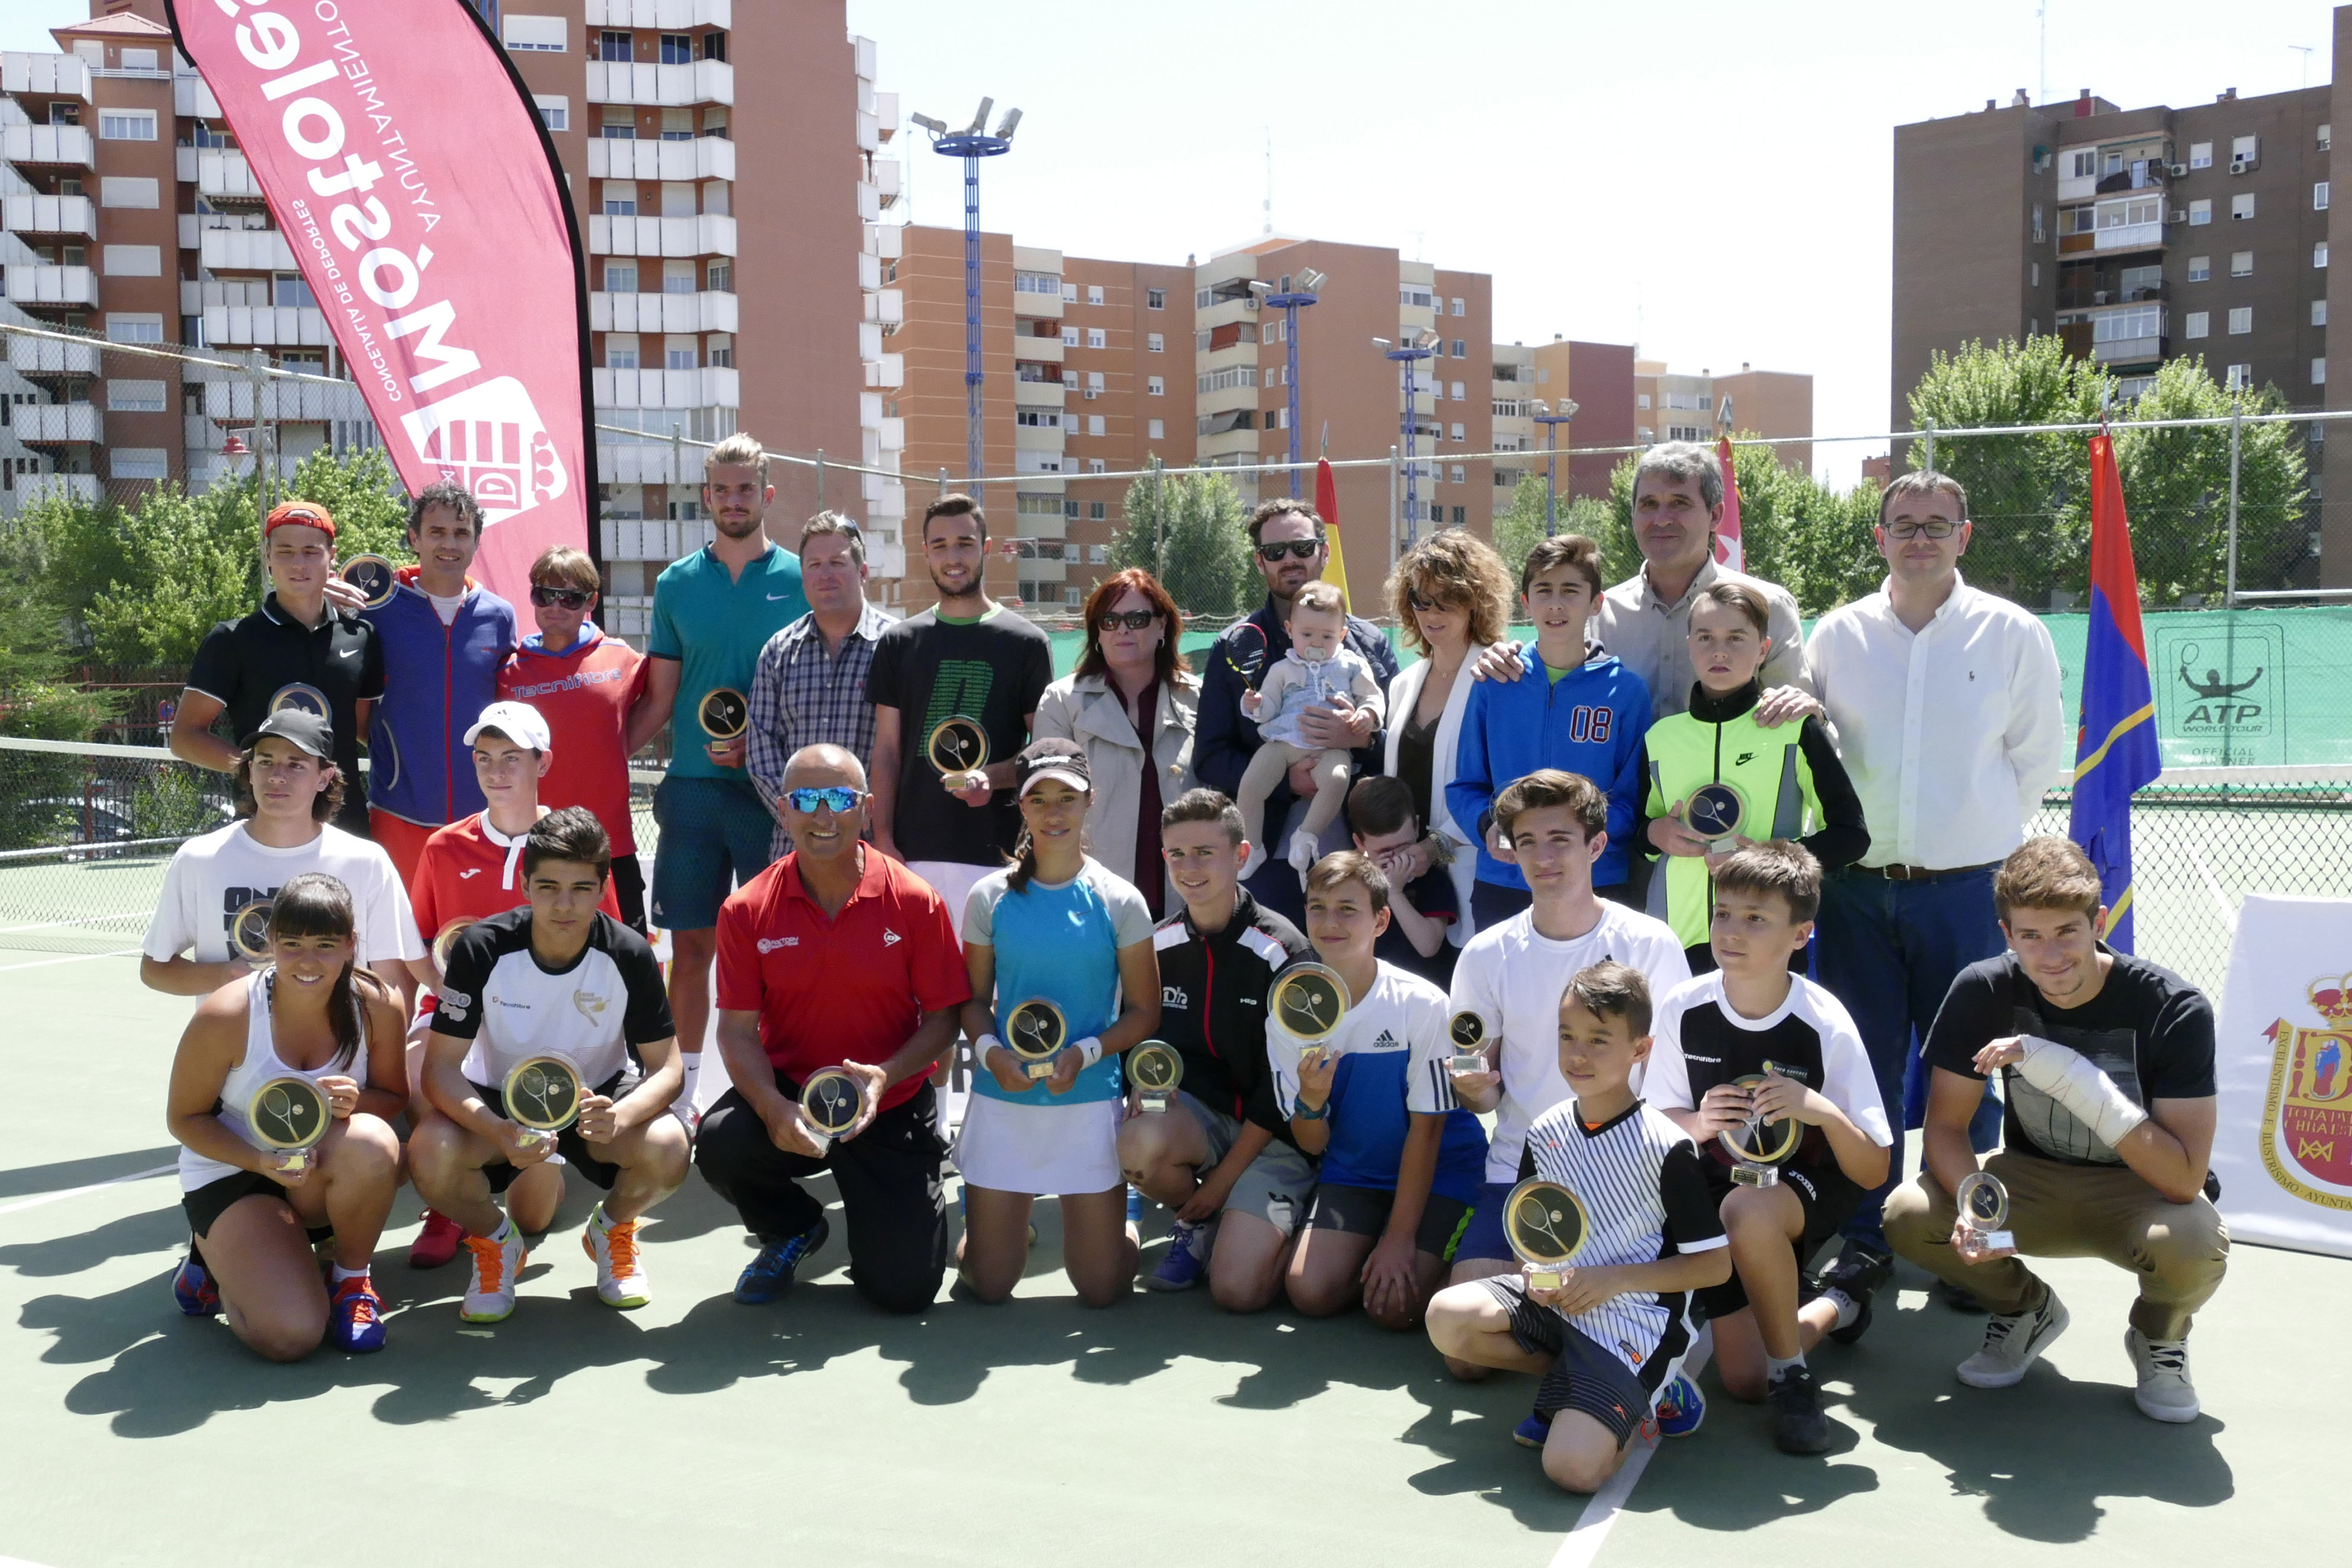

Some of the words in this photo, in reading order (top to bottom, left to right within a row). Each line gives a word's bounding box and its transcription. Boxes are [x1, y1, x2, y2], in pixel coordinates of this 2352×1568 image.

[511, 668, 622, 699] Tecnifibre
[1569, 705, 1613, 744] 08
[2184, 705, 2262, 724] ATP
[2192, 748, 2254, 756] OFFICIAL
[2267, 1031, 2288, 1112] EXCELENTÍSIMO
[2262, 1132, 2299, 1193] ILUSTRÍSIMO
